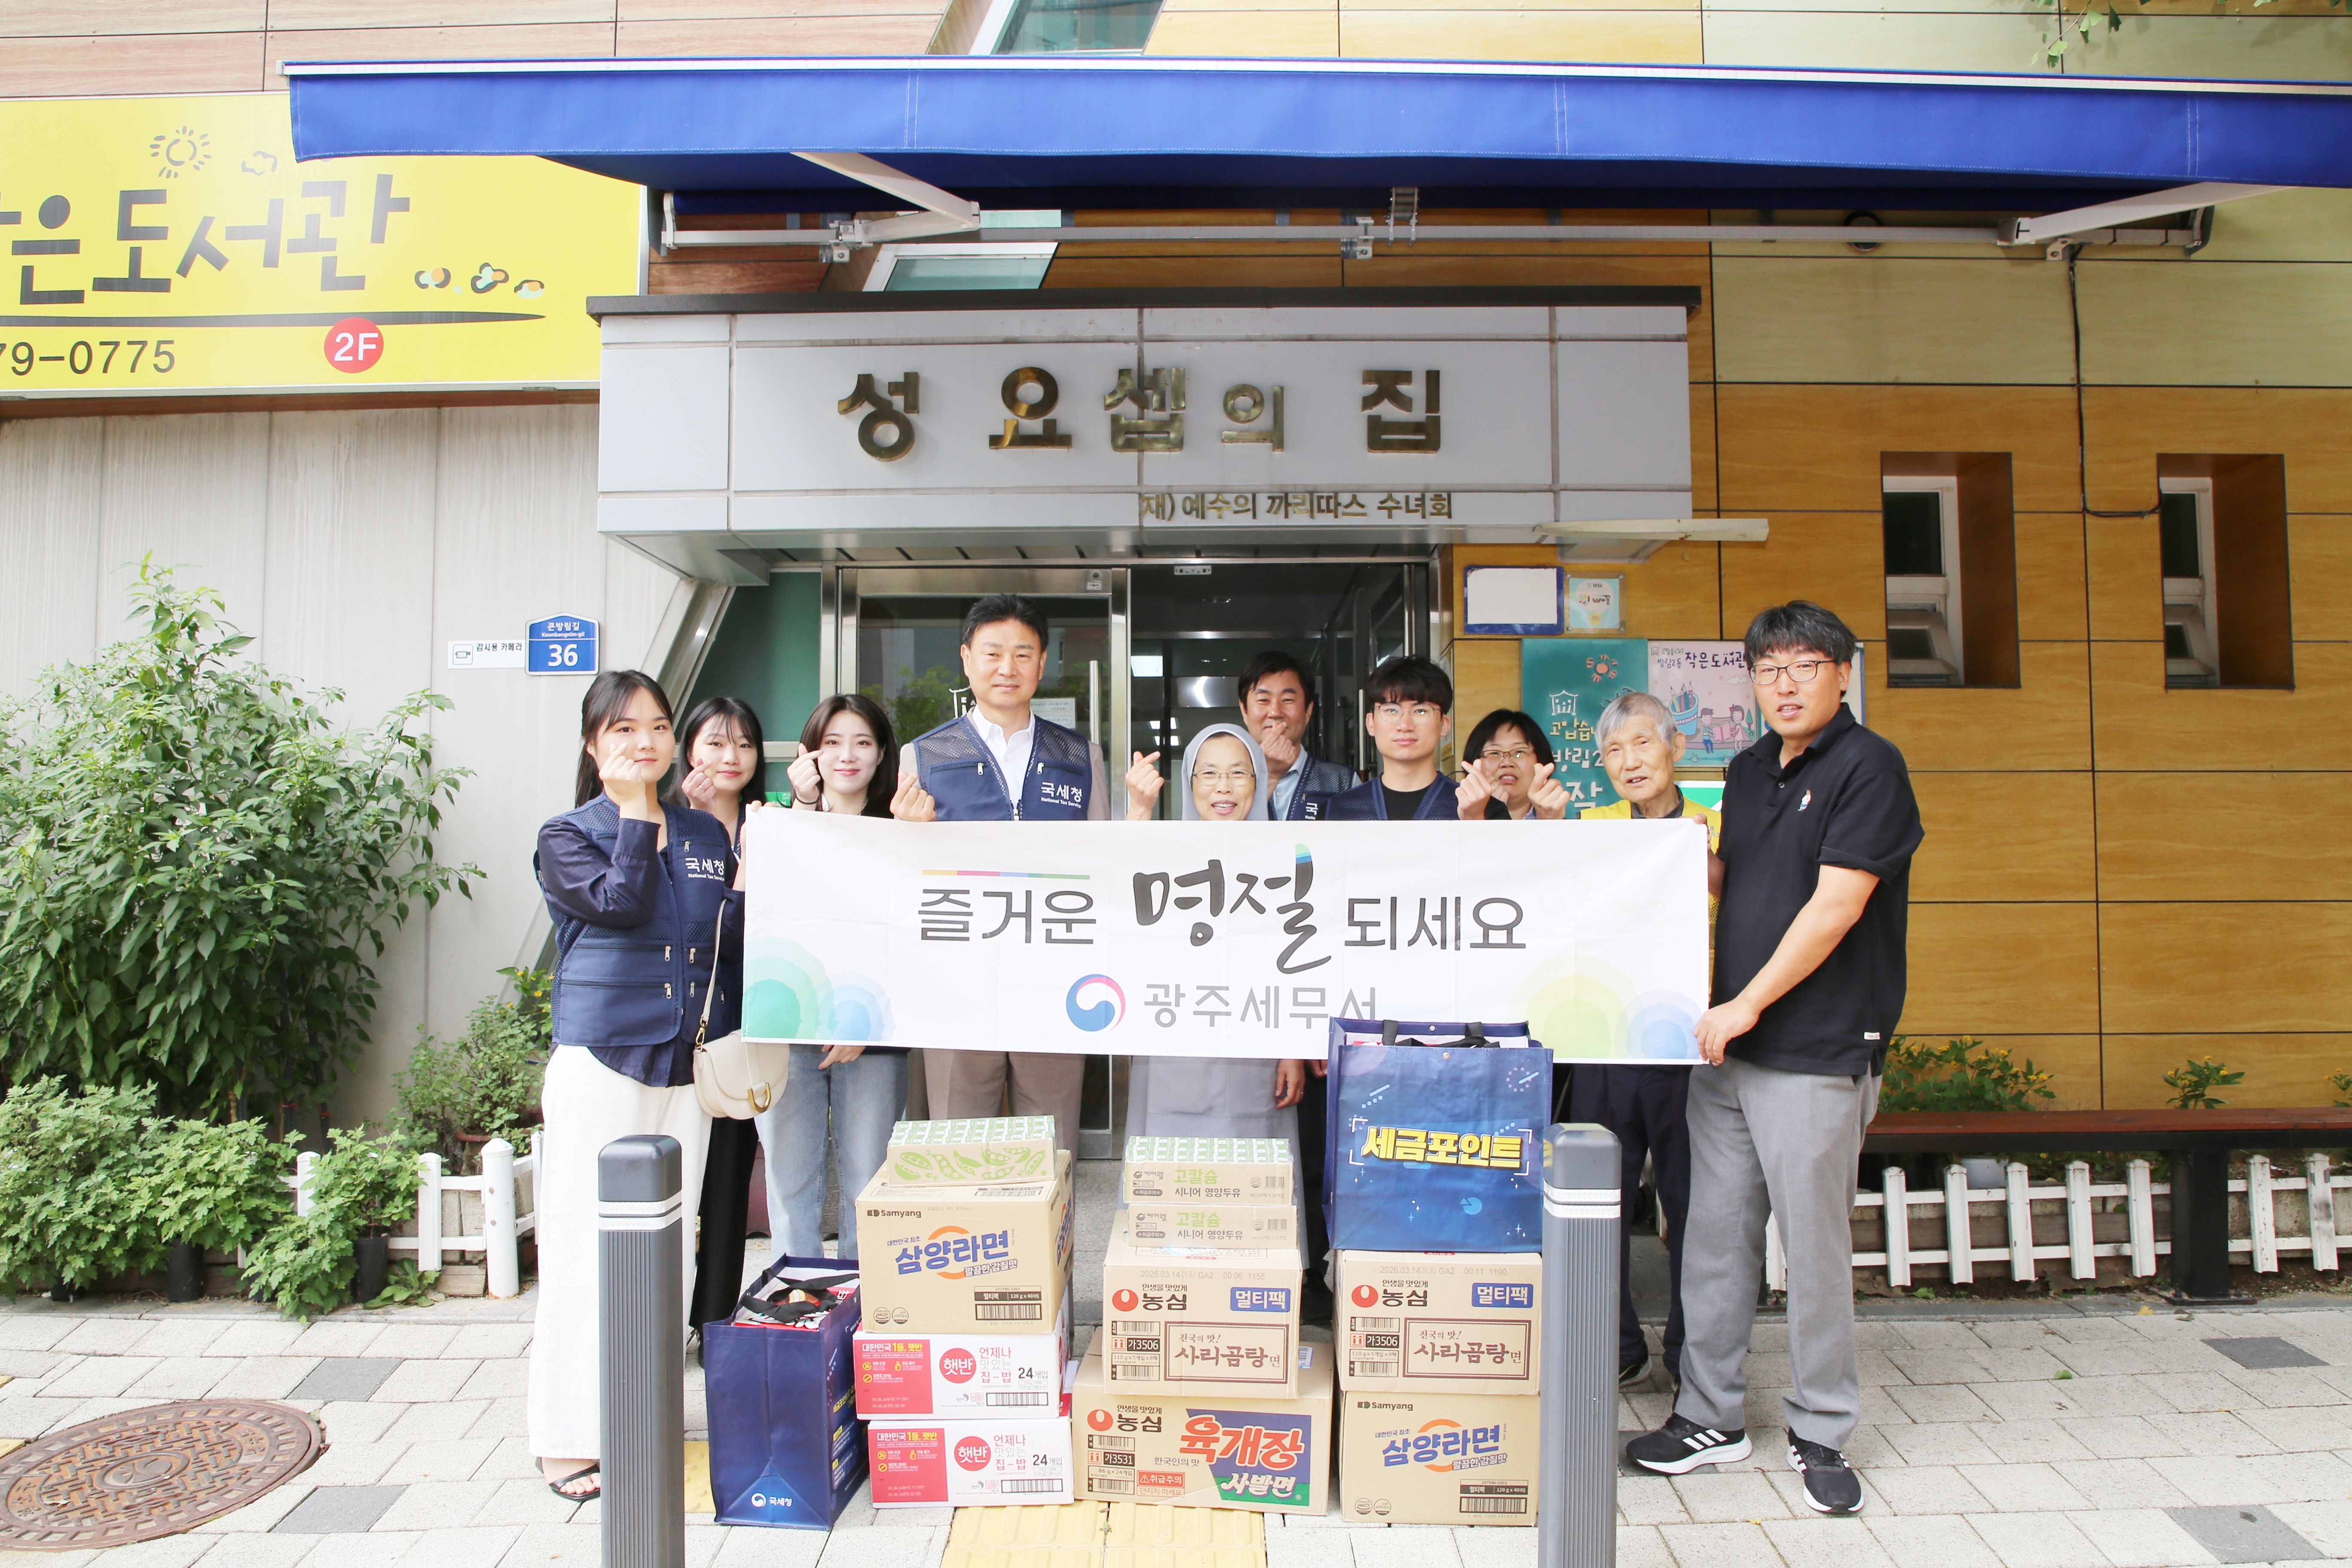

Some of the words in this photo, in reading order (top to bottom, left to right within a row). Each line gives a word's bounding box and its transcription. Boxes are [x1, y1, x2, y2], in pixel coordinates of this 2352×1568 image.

[0, 174, 410, 305] 은도서관
[334, 332, 379, 362] 2F
[838, 371, 919, 462] 성
[1361, 369, 1441, 454] 집
[1265, 494, 1368, 520] 까리따스
[1376, 493, 1452, 520] 수녀회
[547, 622, 580, 631] 큰방림길
[548, 644, 579, 667] 36
[1658, 658, 1682, 668] 방림2동
[1041, 781, 1082, 802] 국세청
[1306, 803, 1318, 815] 국
[685, 858, 724, 876] 국세청
[918, 888, 1097, 946] 즐거운
[1132, 844, 1332, 974] 명절
[1345, 895, 1527, 952] 되세요
[1143, 983, 1376, 1034] 광주세무서
[1361, 1126, 1522, 1168] 세금포인트
[1144, 1171, 1164, 1179] 케어웰
[1174, 1169, 1218, 1185] 고칼슘
[1175, 1187, 1201, 1197] 시니어
[1205, 1188, 1241, 1198] 영양두유
[881, 1210, 921, 1218] Samyang
[1147, 1213, 1166, 1222] 케어웰
[1176, 1212, 1221, 1227] 고칼슘
[1178, 1230, 1204, 1240] 시니어
[1207, 1230, 1243, 1240] 영양두유
[887, 1237, 909, 1246] 대한민국
[895, 1230, 1009, 1275] 삼양라면
[965, 1263, 990, 1277] 깔끔한
[990, 1259, 1018, 1274] 감칠맛
[1380, 1266, 1436, 1274] 2026.03.14까지
[1140, 1270, 1195, 1279] 2026.03.14까지
[1198, 1271, 1214, 1279] GA2
[1142, 1292, 1187, 1311] 농심
[1235, 1291, 1286, 1309] 멀티팩
[1382, 1289, 1427, 1307] 농심
[1477, 1286, 1528, 1305] 멀티팩
[1179, 1334, 1204, 1343] 진국의
[1207, 1334, 1221, 1344] 맛!
[1367, 1336, 1398, 1346] 가3506
[1419, 1330, 1444, 1339] 진국의
[1447, 1330, 1461, 1340] 맛!
[862, 1343, 891, 1352] 대한민국
[892, 1343, 906, 1352] 1등,
[908, 1343, 922, 1351] 햇반
[1128, 1339, 1158, 1350] 가3506
[979, 1347, 1012, 1359] 언제나
[1174, 1345, 1280, 1368] 사리곰탕면
[1414, 1341, 1521, 1364] 사리곰탕면
[943, 1358, 973, 1375] 햇반
[980, 1360, 1011, 1370] 맛있는
[1018, 1367, 1048, 1379] 24개입
[1117, 1405, 1138, 1413] 인생을
[1140, 1406, 1162, 1415] 맛있게
[1372, 1403, 1413, 1411] Samyang
[1117, 1414, 1161, 1433] 농심
[877, 1433, 906, 1441] 대한민국
[907, 1432, 921, 1441] 1등,
[922, 1432, 937, 1440] 햇반
[994, 1435, 1026, 1446] 언제나
[1179, 1417, 1304, 1470] 육개장
[1382, 1425, 1500, 1467] 삼양라면
[958, 1446, 988, 1463] 햇반
[995, 1447, 1026, 1458] 맛있는
[1033, 1454, 1062, 1466] 24개입
[1105, 1454, 1133, 1464] 가3531
[1155, 1457, 1189, 1467] 한국인의
[1191, 1458, 1200, 1467] 맛
[1452, 1458, 1479, 1470] 깔끔한
[1479, 1454, 1507, 1467] 감칠맛
[1149, 1474, 1182, 1485] 취급주의
[1139, 1487, 1161, 1495] 던지지
[1221, 1472, 1296, 1500] 사발면
[769, 1496, 792, 1507] 국세청
